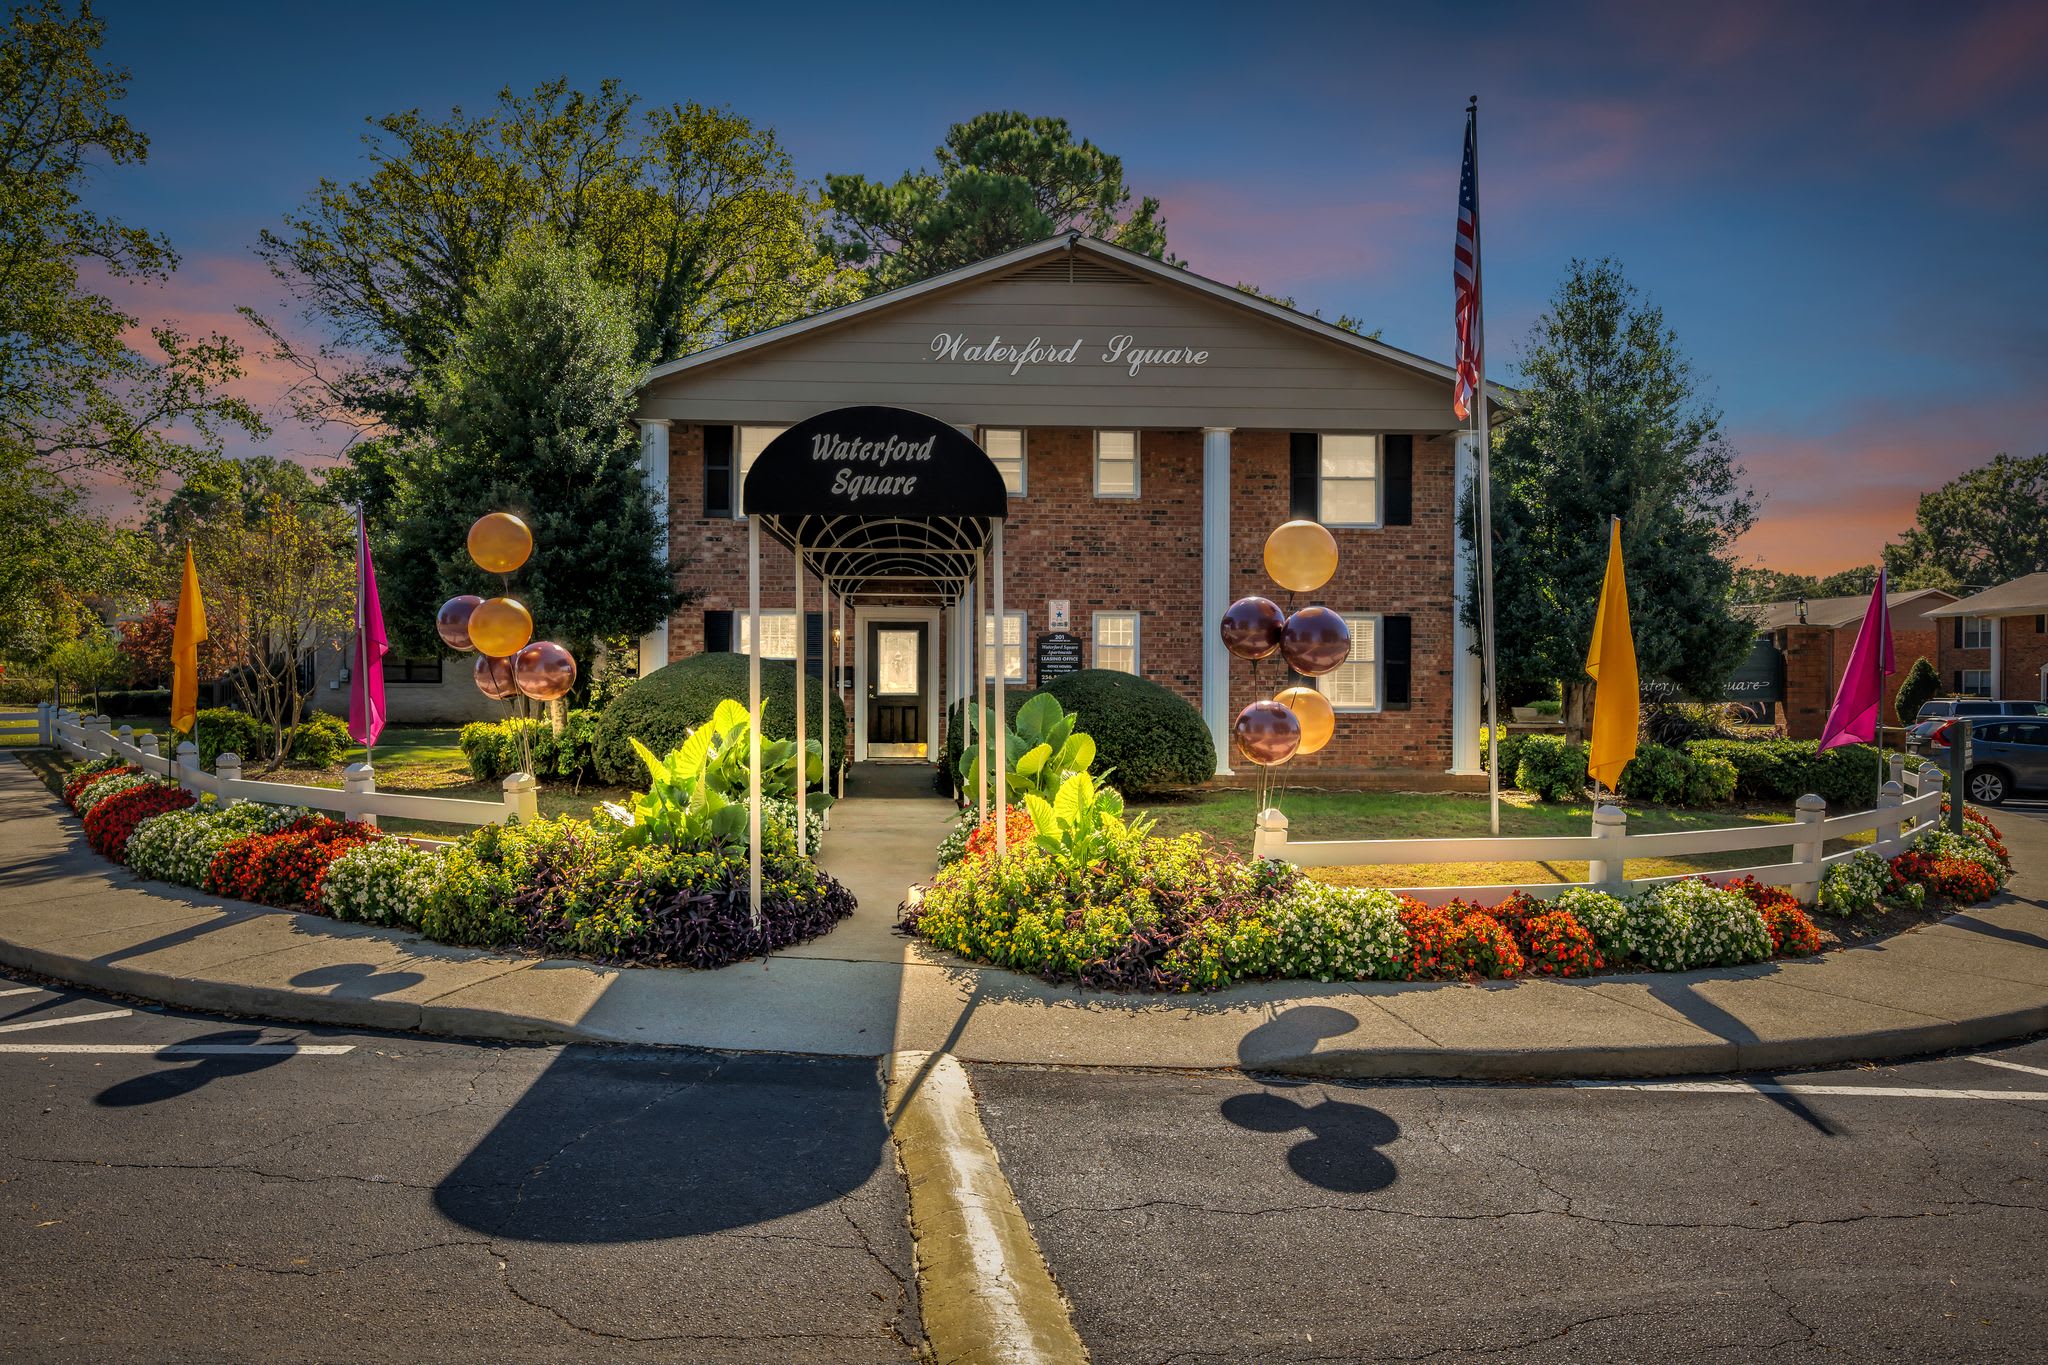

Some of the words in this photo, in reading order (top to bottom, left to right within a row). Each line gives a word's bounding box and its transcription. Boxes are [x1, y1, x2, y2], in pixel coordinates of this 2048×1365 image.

[930, 333, 1083, 376] Waterford
[1101, 334, 1209, 377] Square
[812, 433, 937, 467] Waterford
[831, 468, 917, 501] Square
